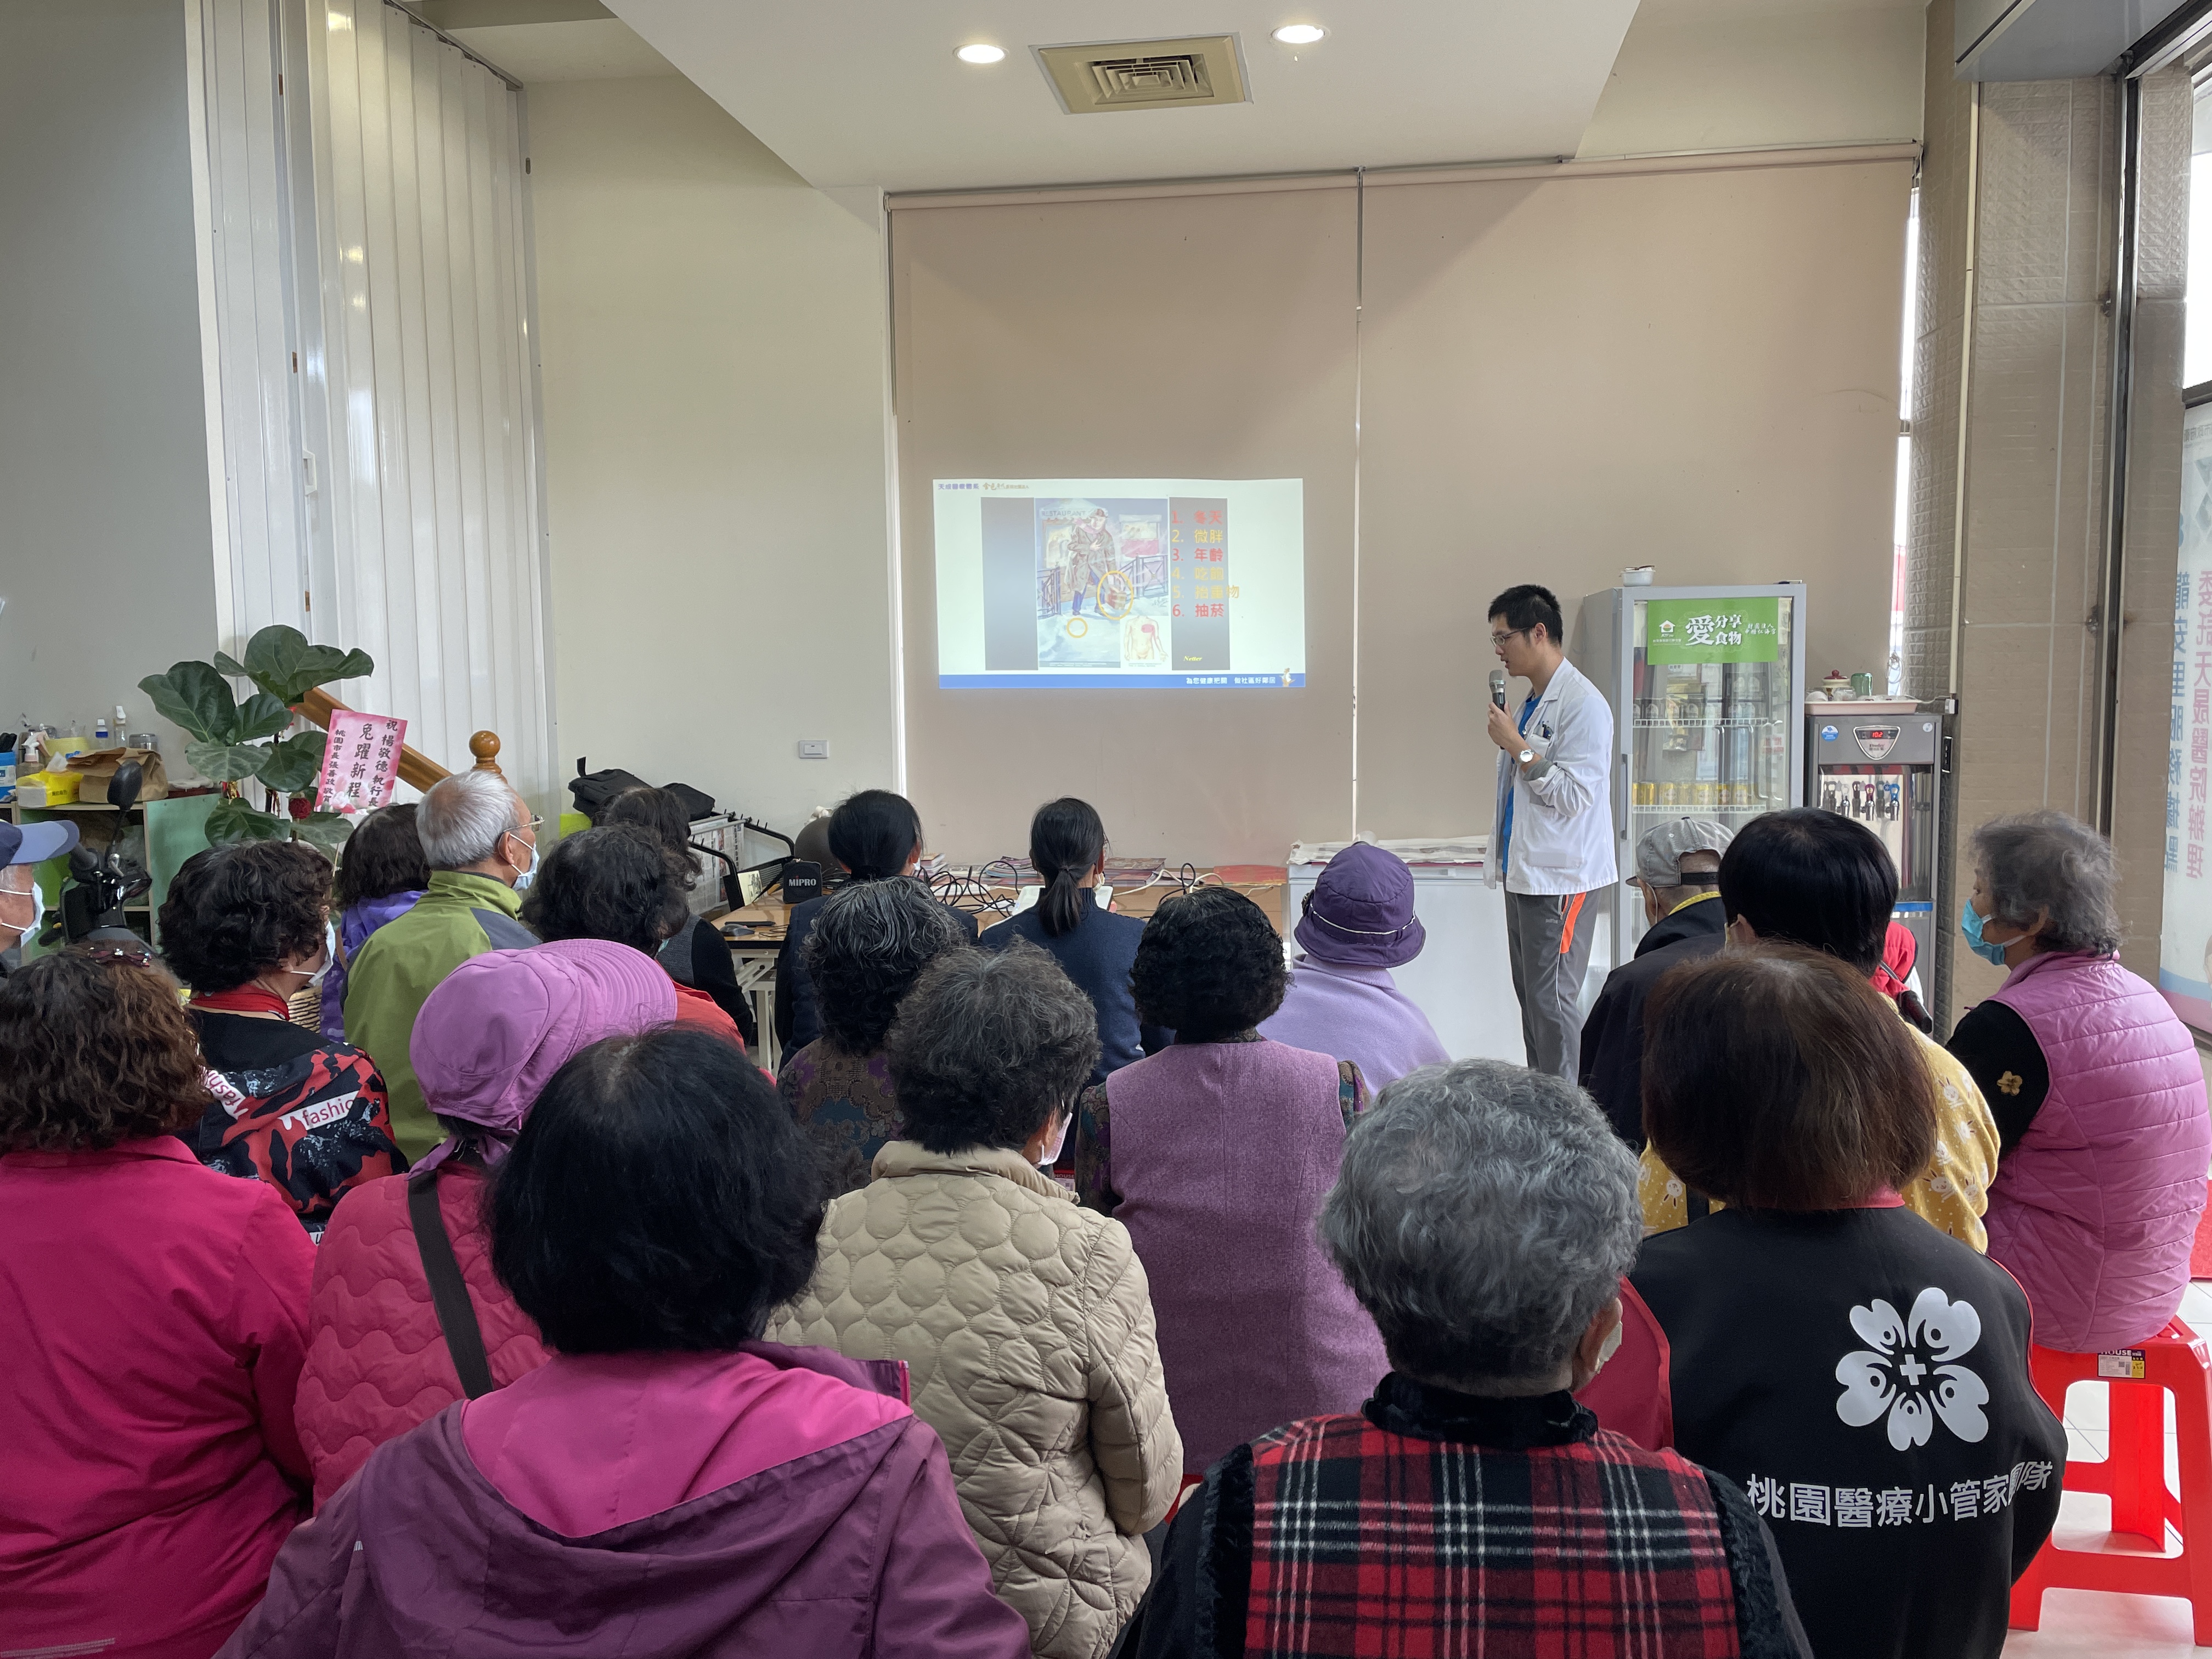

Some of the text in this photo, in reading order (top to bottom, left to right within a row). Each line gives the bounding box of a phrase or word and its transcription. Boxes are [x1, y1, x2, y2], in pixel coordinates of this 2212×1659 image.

[1194, 510, 1223, 525] 冬天
[1194, 529, 1223, 543] 微胖
[1194, 548, 1223, 562] 年齡
[1194, 567, 1224, 580] 吃飽
[1195, 603, 1224, 618] 抽菸
[347, 723, 374, 798] 兔躍新程
[789, 876, 816, 886] MIPRO
[1747, 1461, 2052, 1528] 桃園醫療小管家團隊
